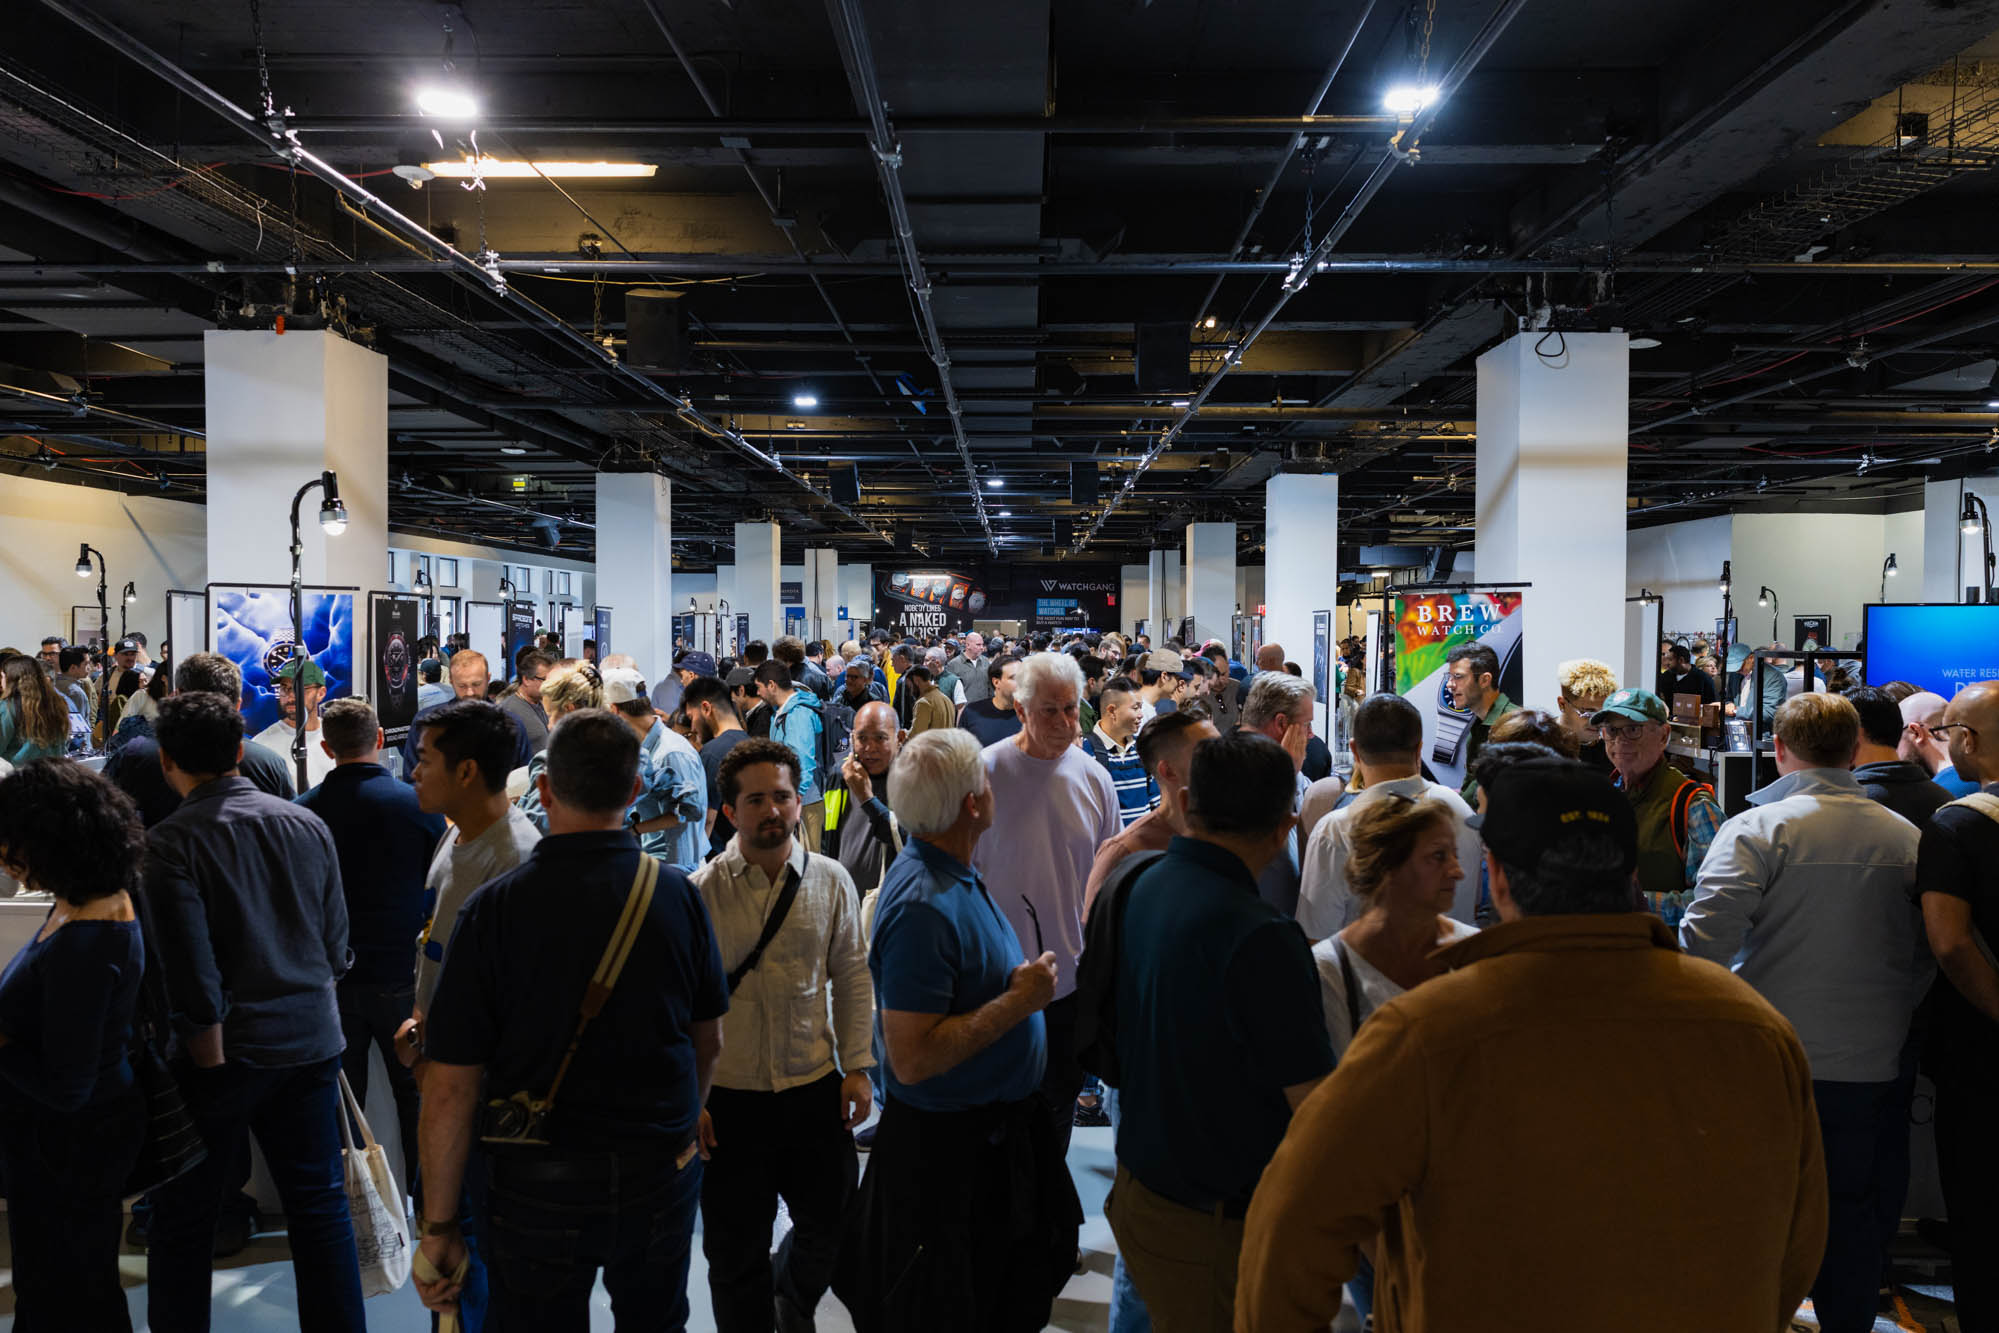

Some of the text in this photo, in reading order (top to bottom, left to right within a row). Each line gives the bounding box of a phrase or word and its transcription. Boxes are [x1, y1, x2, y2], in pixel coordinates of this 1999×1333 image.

[1059, 583, 1115, 591] WATCHGANG
[1417, 603, 1501, 622] BREW
[899, 612, 946, 627] A NAKED
[1417, 625, 1475, 636] WATCH
[1942, 668, 1976, 678] WATER
